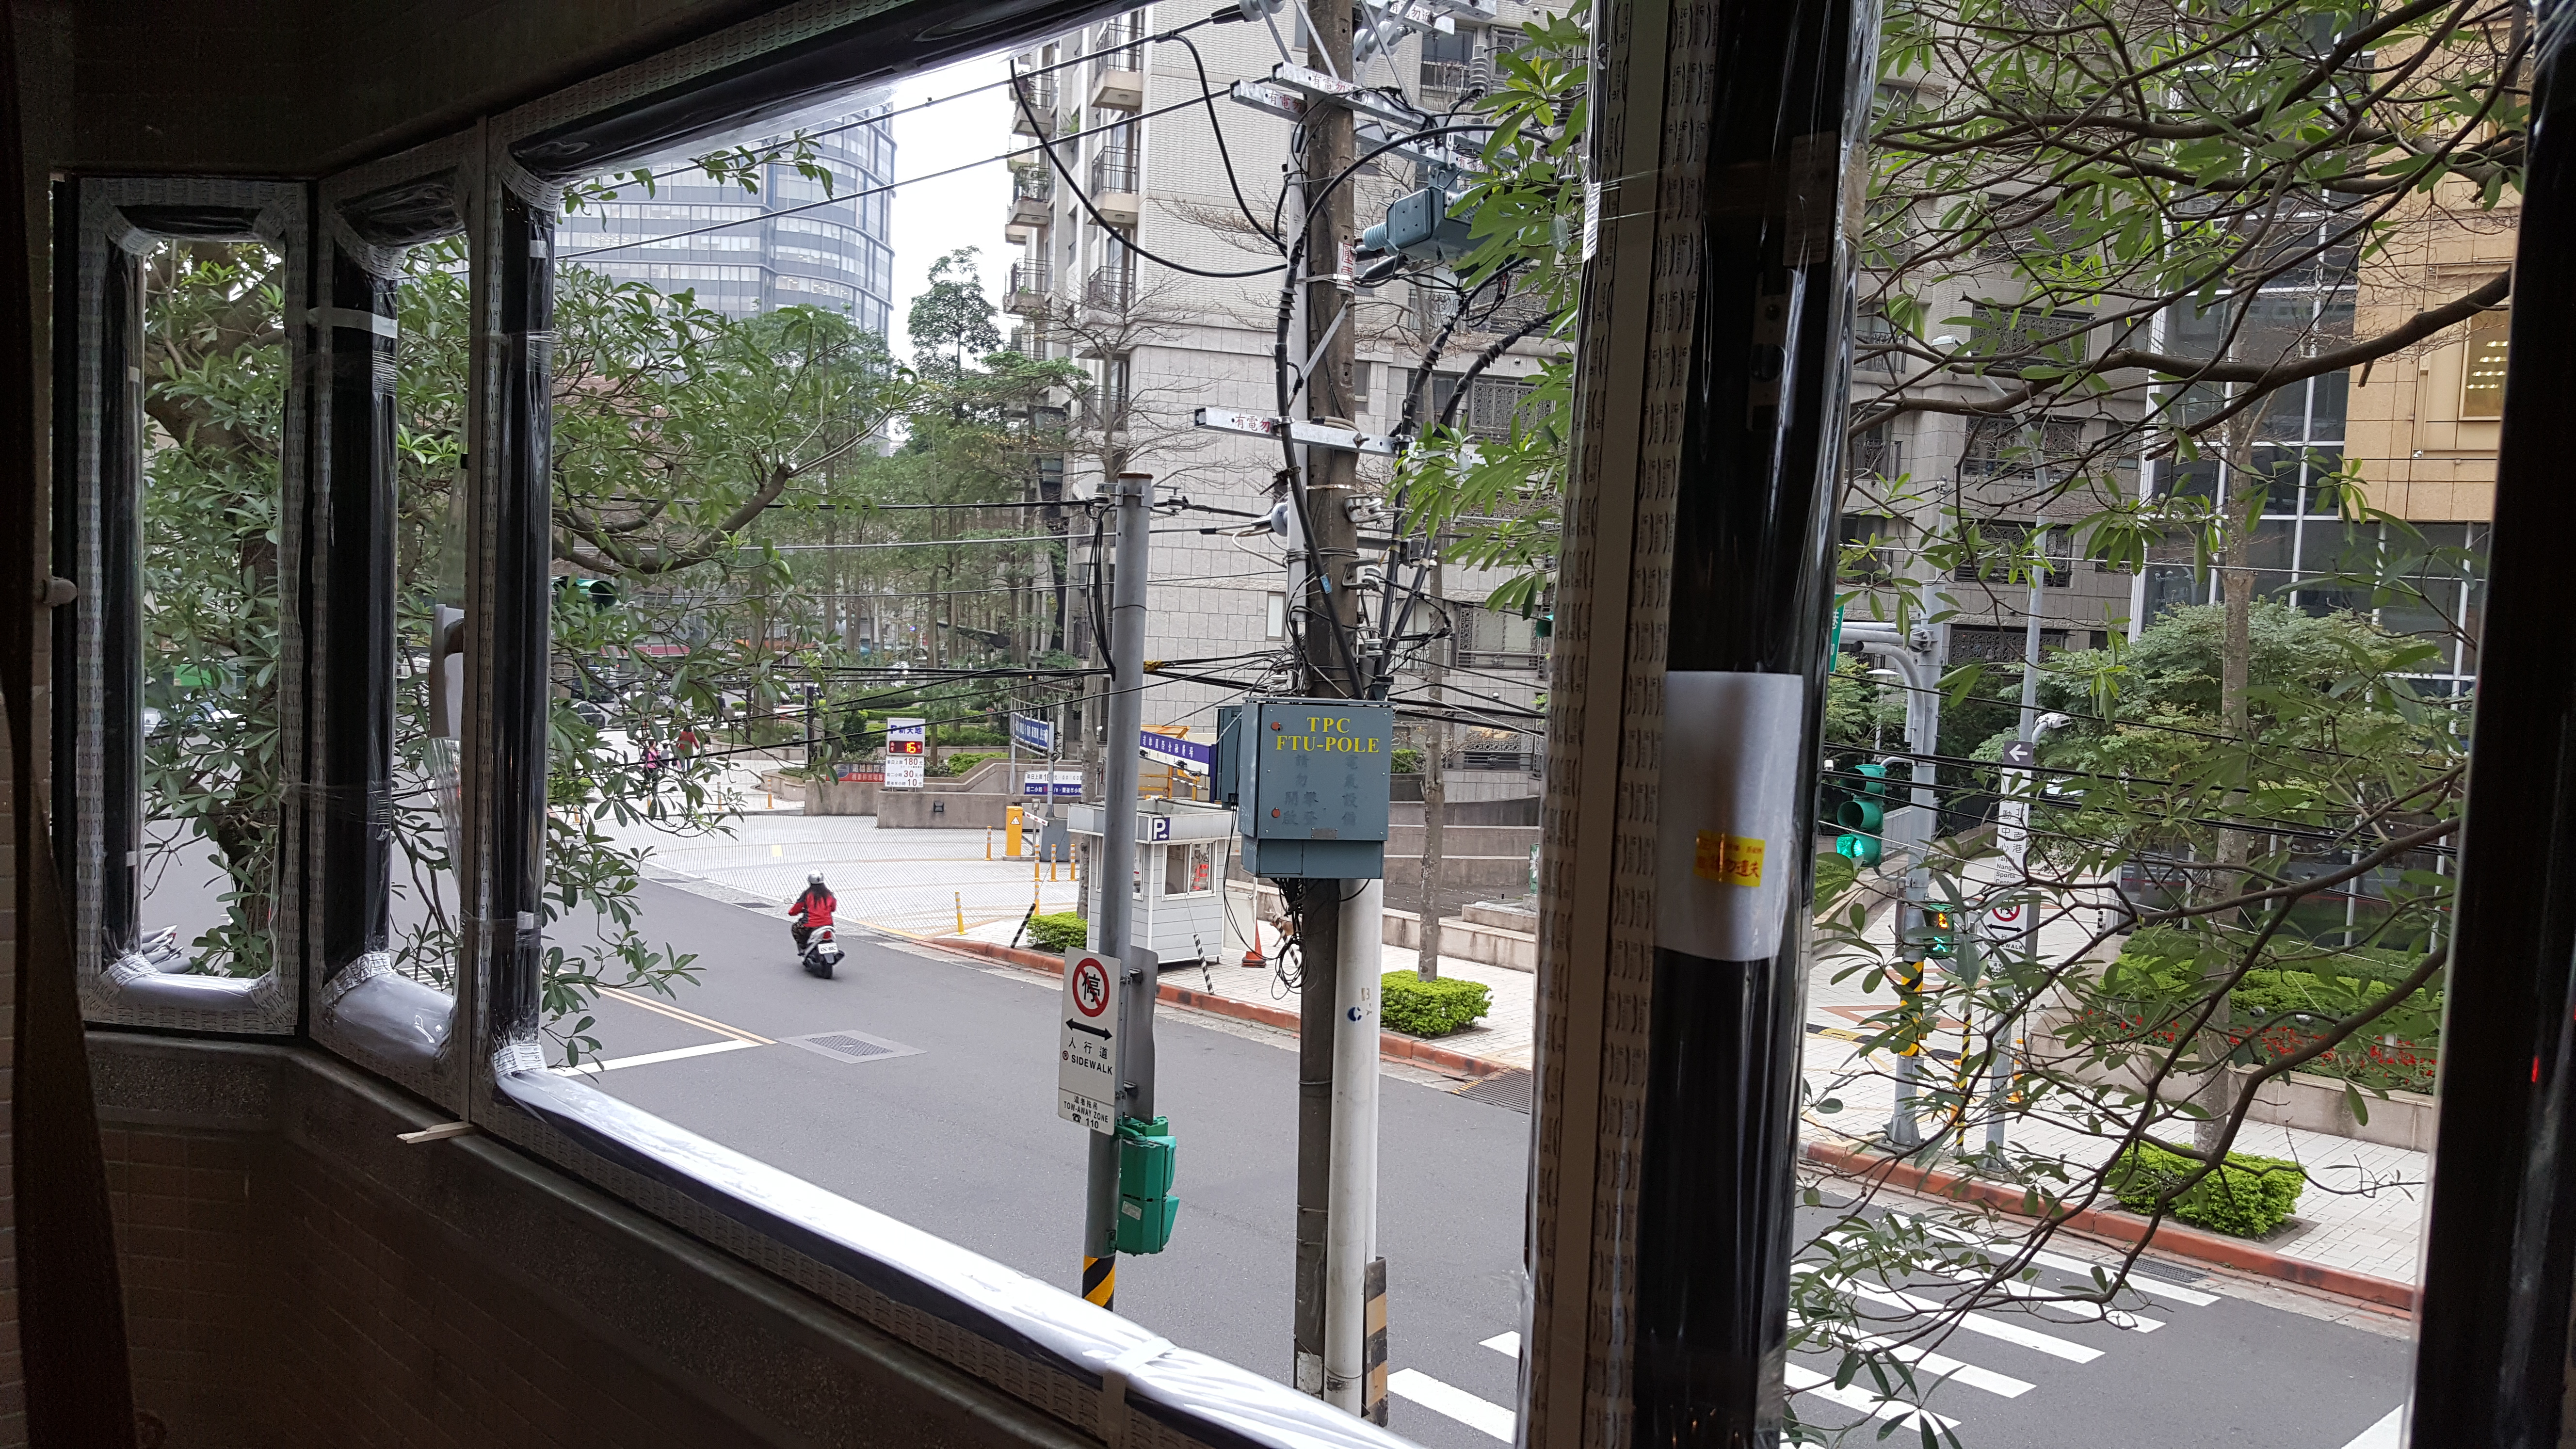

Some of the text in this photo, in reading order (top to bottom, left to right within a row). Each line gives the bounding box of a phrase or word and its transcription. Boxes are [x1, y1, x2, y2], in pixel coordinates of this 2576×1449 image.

[1306, 717, 1351, 733] TPC
[906, 742, 916, 753] 16
[1276, 735, 1380, 753] FTU-POLE
[1153, 819, 1166, 840] P
[1082, 972, 1101, 1002] 停
[1068, 1036, 1108, 1060] 人行道
[1071, 1054, 1113, 1076] SIDEWALK
[1063, 1101, 1109, 1123] TOW-AWAY ZONE
[1074, 1095, 1098, 1110] 違者拖吊
[1086, 1117, 1099, 1129] 110
